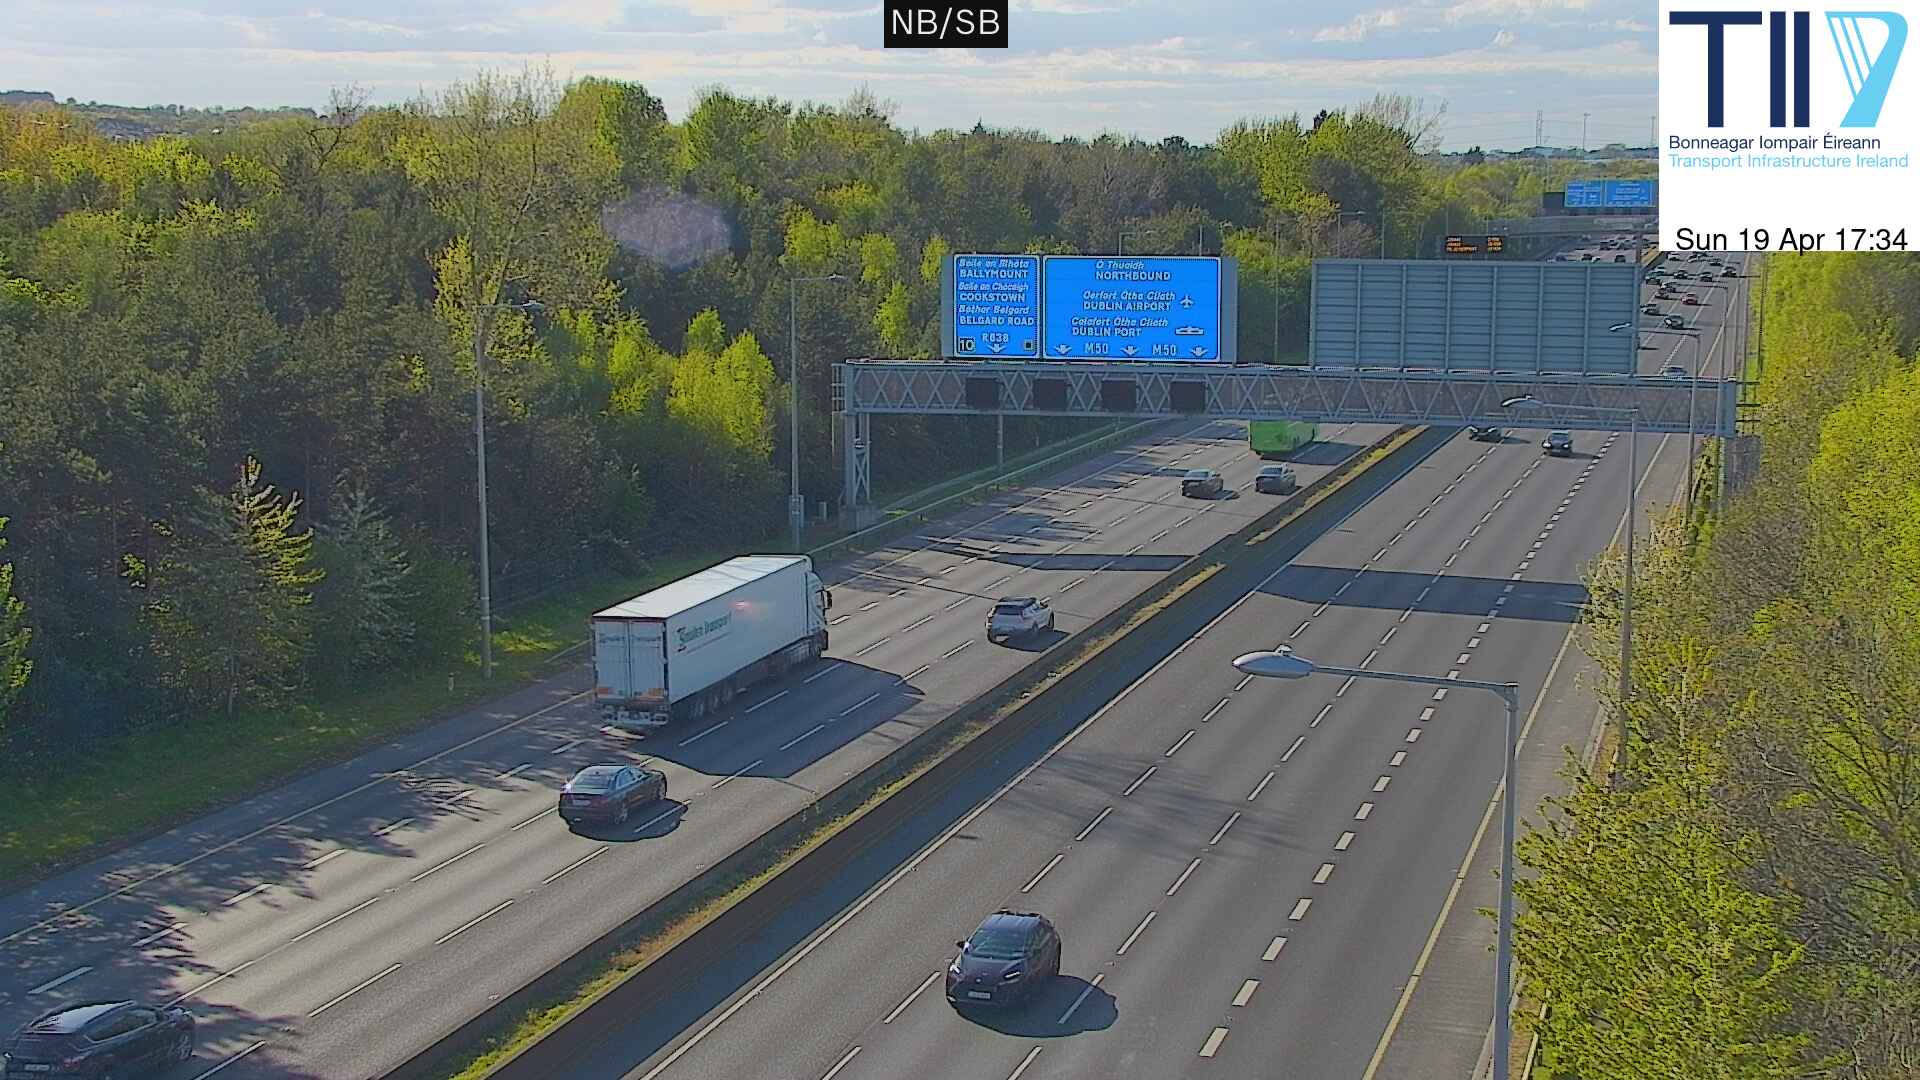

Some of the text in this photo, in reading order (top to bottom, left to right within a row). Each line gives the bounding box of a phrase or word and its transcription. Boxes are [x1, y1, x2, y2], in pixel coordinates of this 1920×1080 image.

[959, 269, 1028, 279] BALLYMOUNT
[1095, 271, 1171, 281] NORTHBOUND
[959, 292, 1026, 303] COOKSTOWN
[1083, 301, 1171, 312] DUBLIN AIRPORT
[959, 315, 1035, 326] BELGARD ROAD
[1072, 327, 1142, 337] DUBLIN PORT
[959, 339, 974, 351] 10
